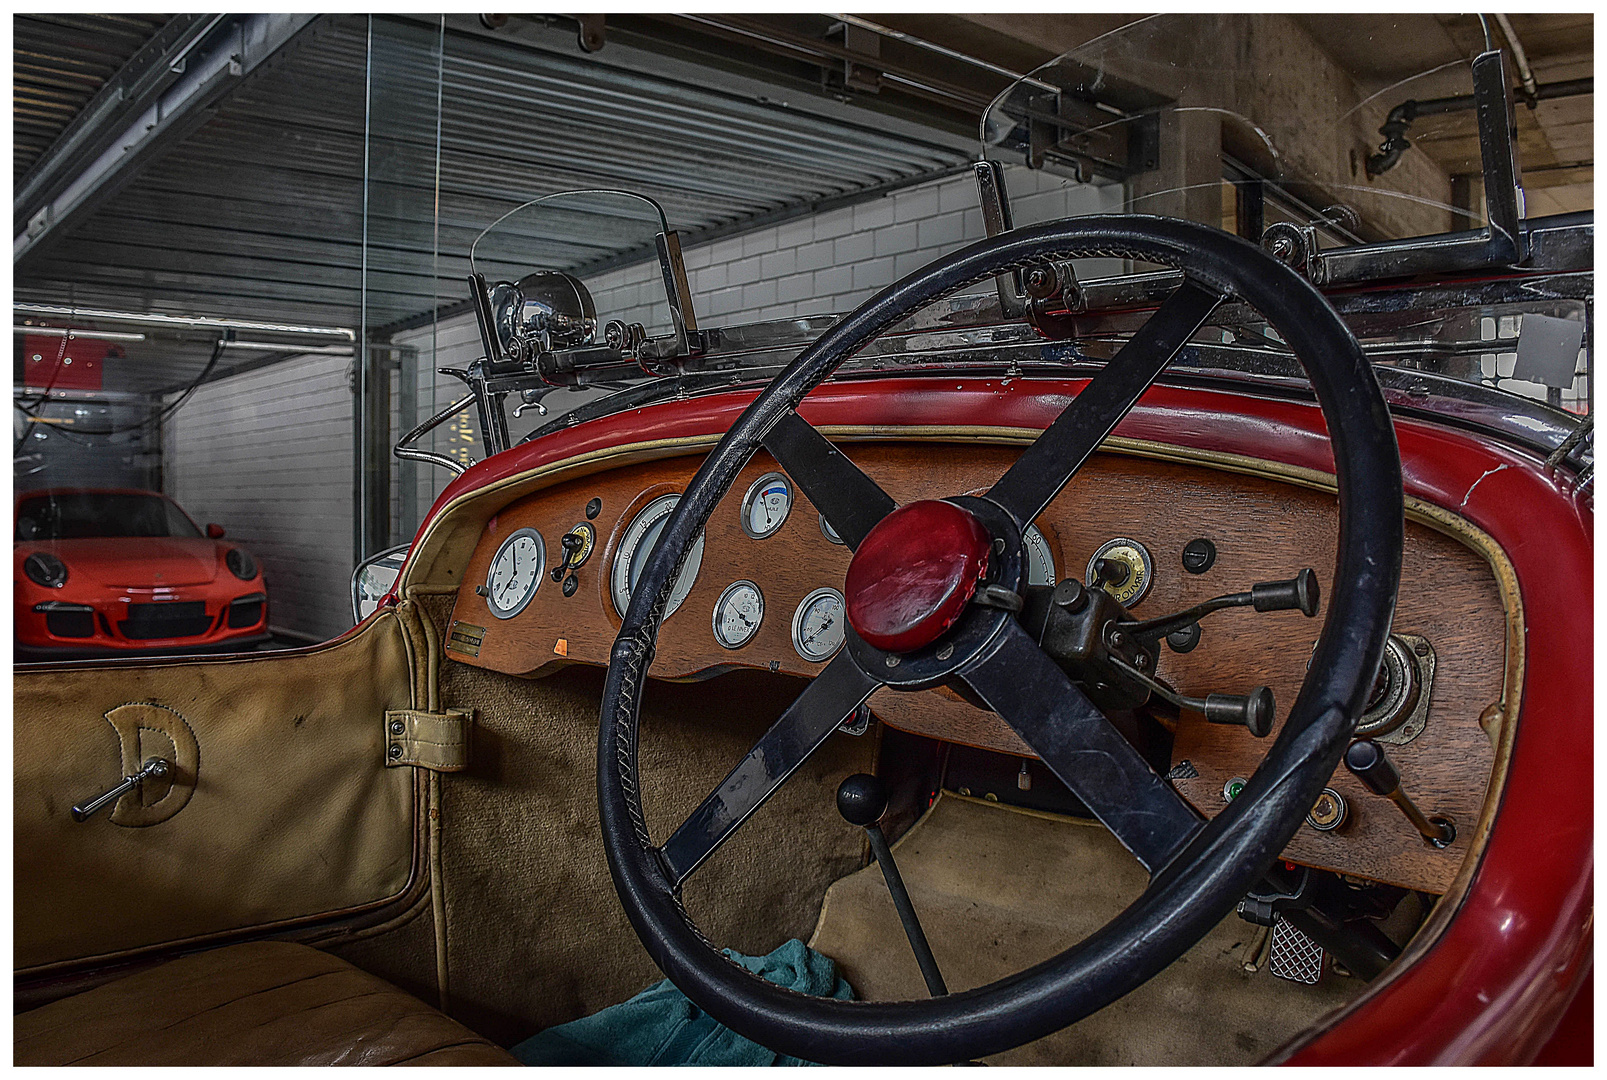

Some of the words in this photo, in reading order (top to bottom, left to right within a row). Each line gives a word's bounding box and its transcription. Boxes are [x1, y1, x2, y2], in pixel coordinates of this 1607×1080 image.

[639, 519, 647, 529] 15
[1032, 533, 1042, 545] 60
[623, 551, 631, 560] 10
